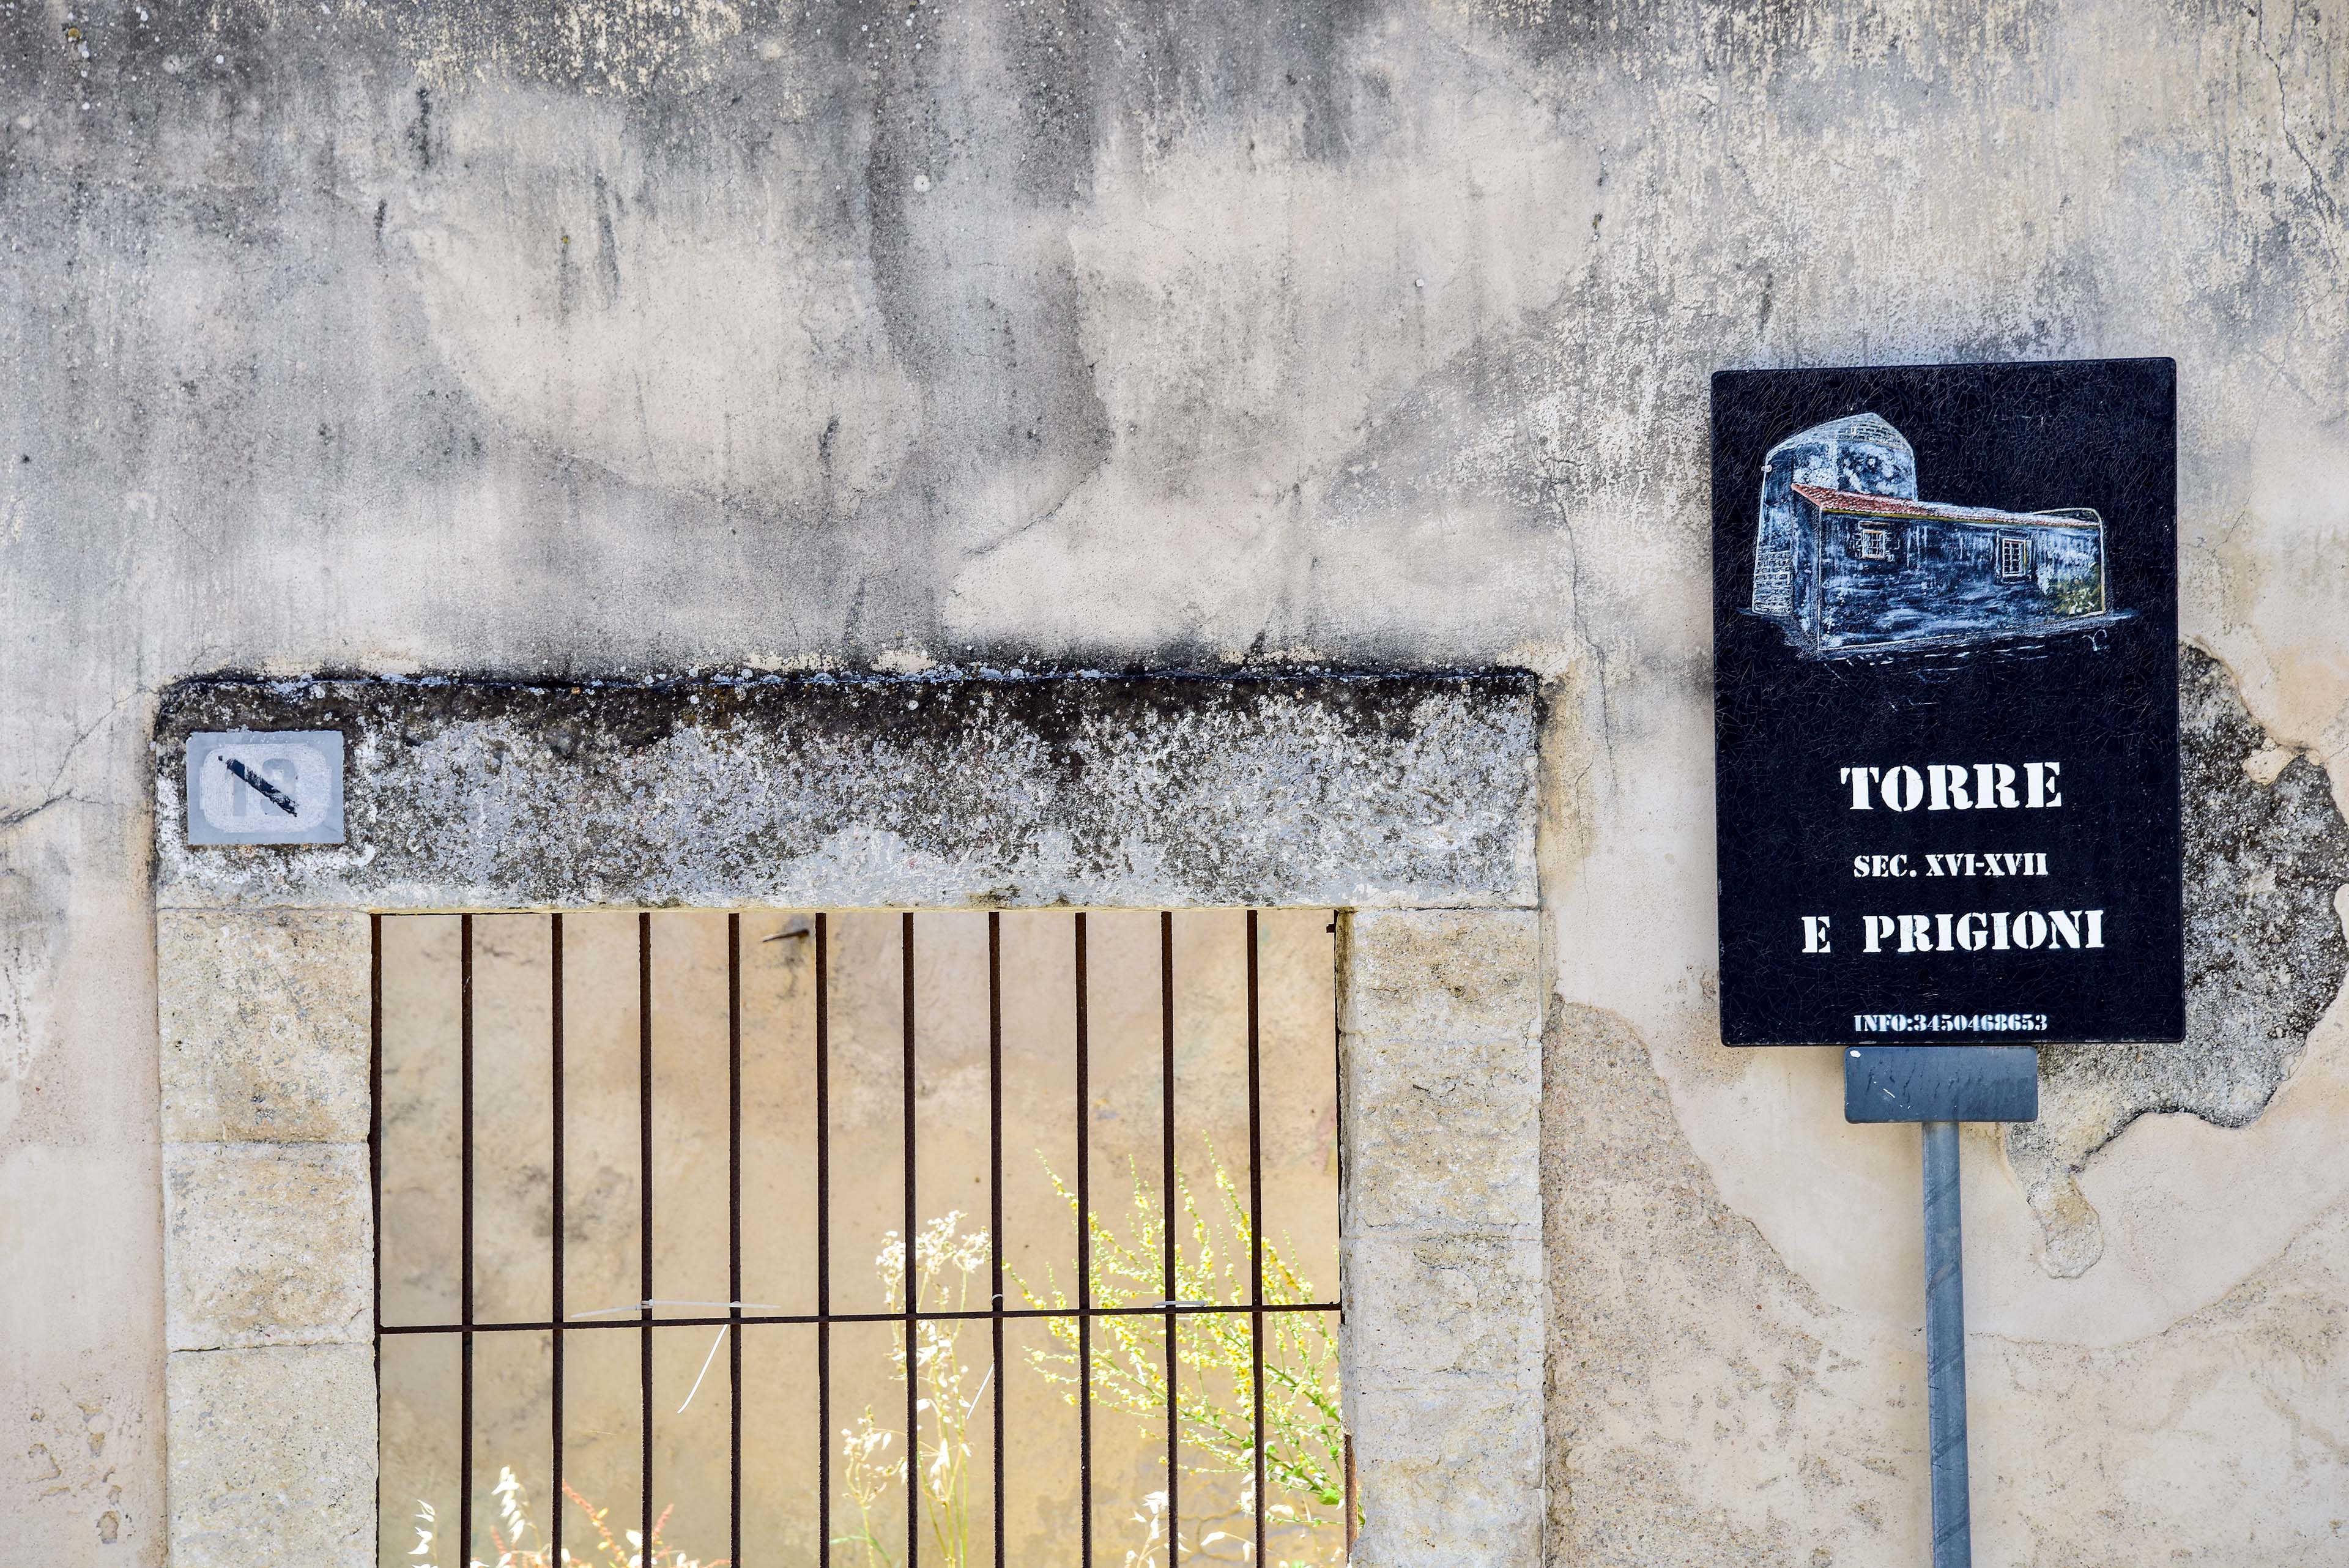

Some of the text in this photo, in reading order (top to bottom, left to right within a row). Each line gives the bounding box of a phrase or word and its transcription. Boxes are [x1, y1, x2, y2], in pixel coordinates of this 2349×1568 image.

[1840, 762, 2062, 812] TORRE
[1854, 852, 2049, 878] SEC. XVI-XVII
[1801, 909, 2105, 954] E PRIGIONI
[1854, 1014, 2047, 1032] INFO:3450468653
